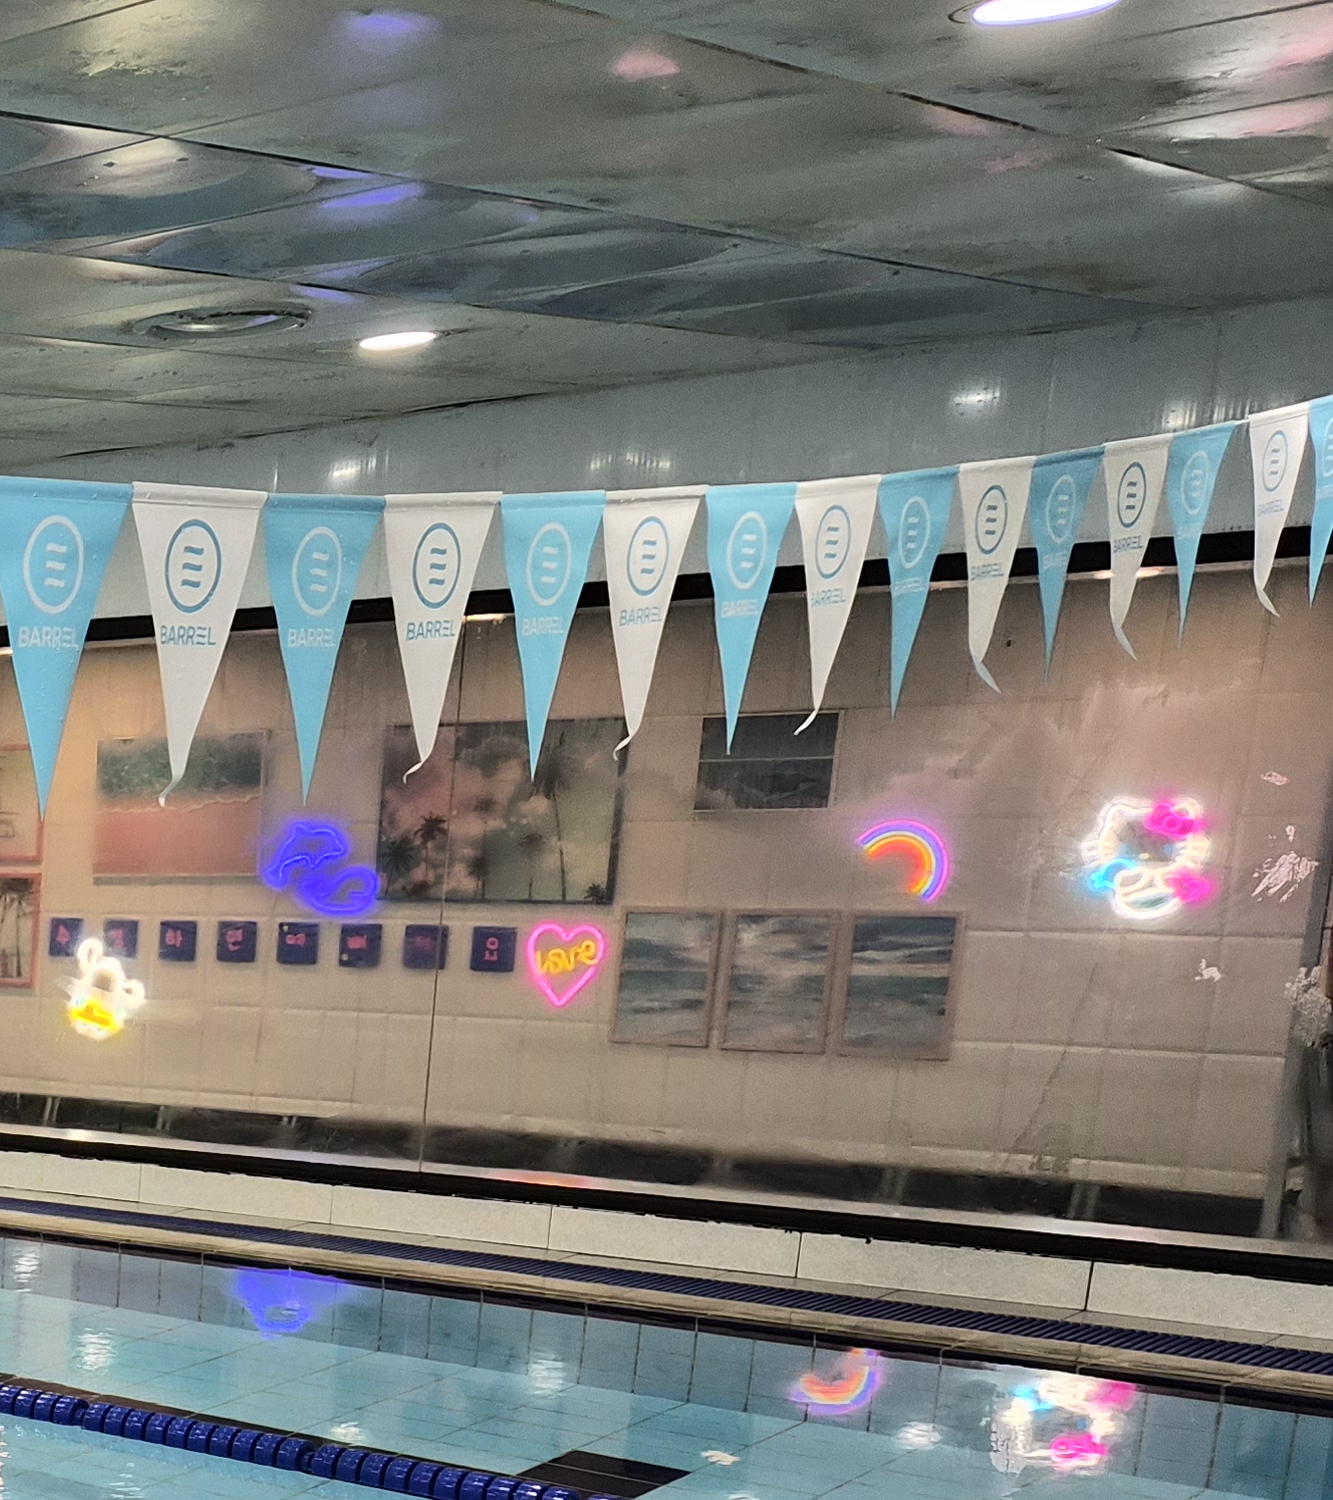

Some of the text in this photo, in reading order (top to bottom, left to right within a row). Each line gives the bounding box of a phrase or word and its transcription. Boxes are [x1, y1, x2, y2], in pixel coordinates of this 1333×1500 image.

[522, 615, 565, 636] BARREL
[619, 606, 663, 628] BARREL
[17, 625, 79, 650] BARREL
[159, 624, 216, 646] BARREL
[287, 628, 336, 648] BARREL
[406, 620, 456, 641] BARREL
